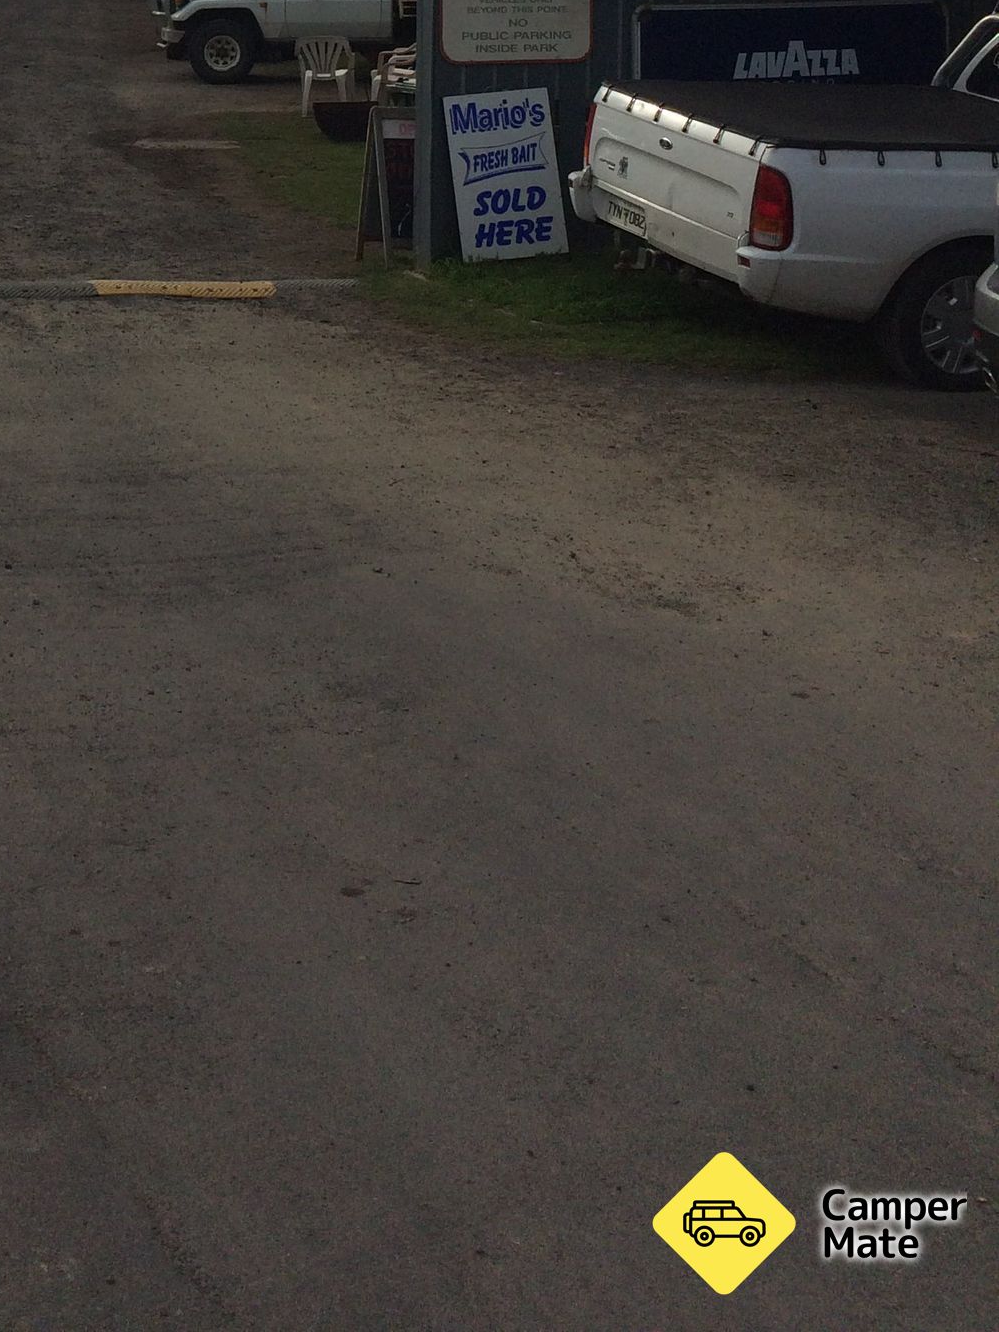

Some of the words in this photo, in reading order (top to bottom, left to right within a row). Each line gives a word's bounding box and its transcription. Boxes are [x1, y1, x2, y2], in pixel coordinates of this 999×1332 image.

[467, 6, 507, 14] BEYOND
[512, 6, 534, 14] THIS
[508, 18, 529, 27] NO
[462, 32, 509, 41] PUBLIC
[514, 31, 572, 40] PARKING
[475, 44, 519, 53] INSIDE
[523, 43, 558, 52] PARK
[732, 40, 860, 80] LAVAZZA
[449, 98, 546, 135] Mario's
[473, 151, 509, 173] FRESH
[511, 143, 538, 165] BAIT
[473, 186, 547, 216] SOLD
[475, 216, 553, 248] HERE
